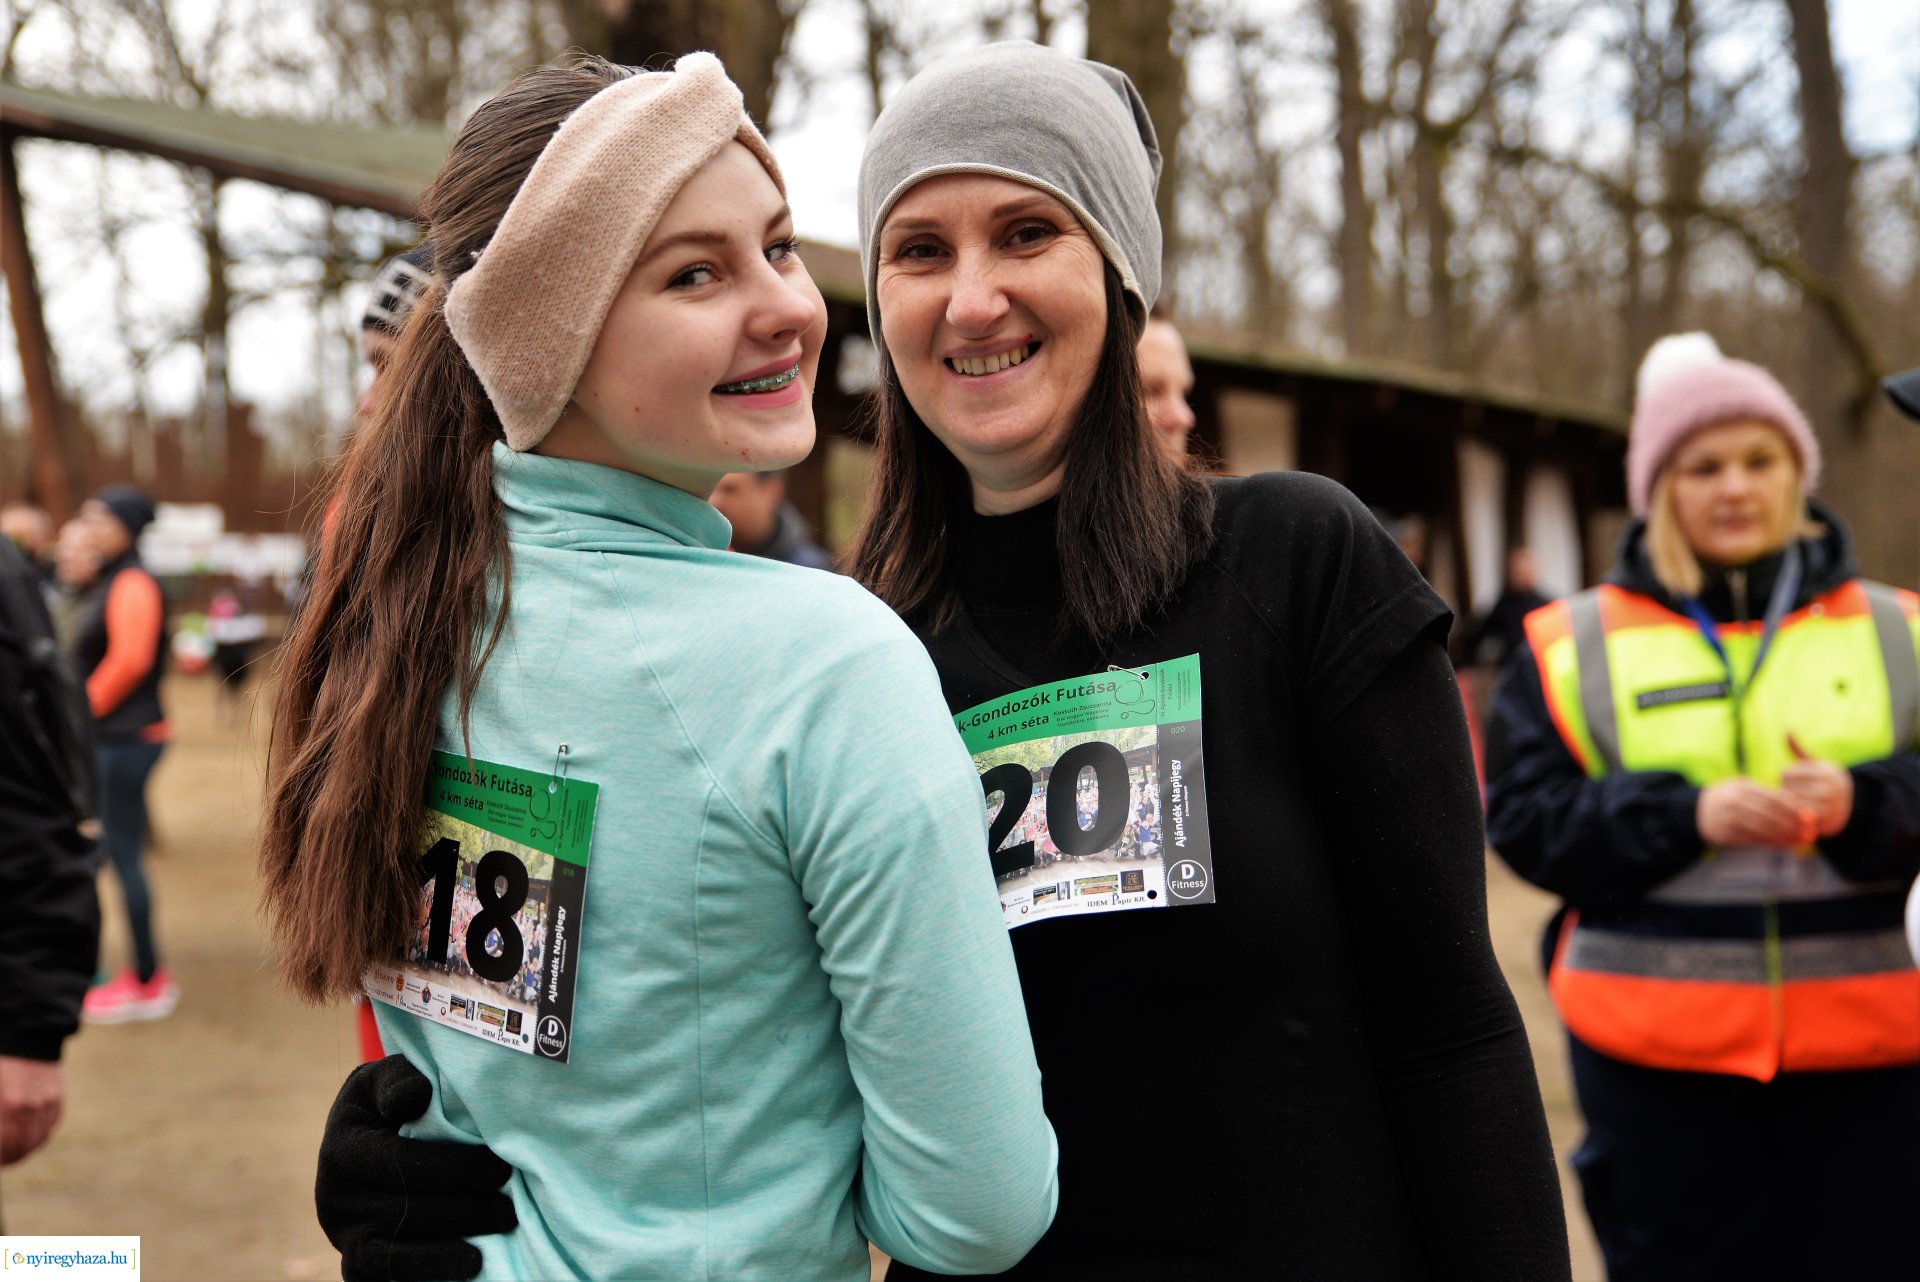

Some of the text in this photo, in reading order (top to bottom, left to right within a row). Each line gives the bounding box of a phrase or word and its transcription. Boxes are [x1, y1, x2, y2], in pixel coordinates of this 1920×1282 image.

[1056, 681, 1117, 701] Futása
[1053, 706, 1078, 717] Kossuth
[987, 730, 995, 740] 4
[998, 724, 1018, 736] km
[1021, 715, 1050, 730] séta
[1170, 725, 1186, 734] 020
[490, 774, 533, 797] Futása
[439, 790, 484, 811] 4 km séta
[980, 741, 1131, 877] 20
[1170, 760, 1186, 848] Ajándék Napijegy
[1181, 864, 1195, 880] D
[1171, 880, 1205, 890] Fitness
[421, 837, 529, 983] 18
[552, 906, 567, 955] Napijegy
[548, 956, 560, 1003] Ajándék
[548, 1019, 558, 1036] D
[539, 1034, 563, 1048] Fitness
